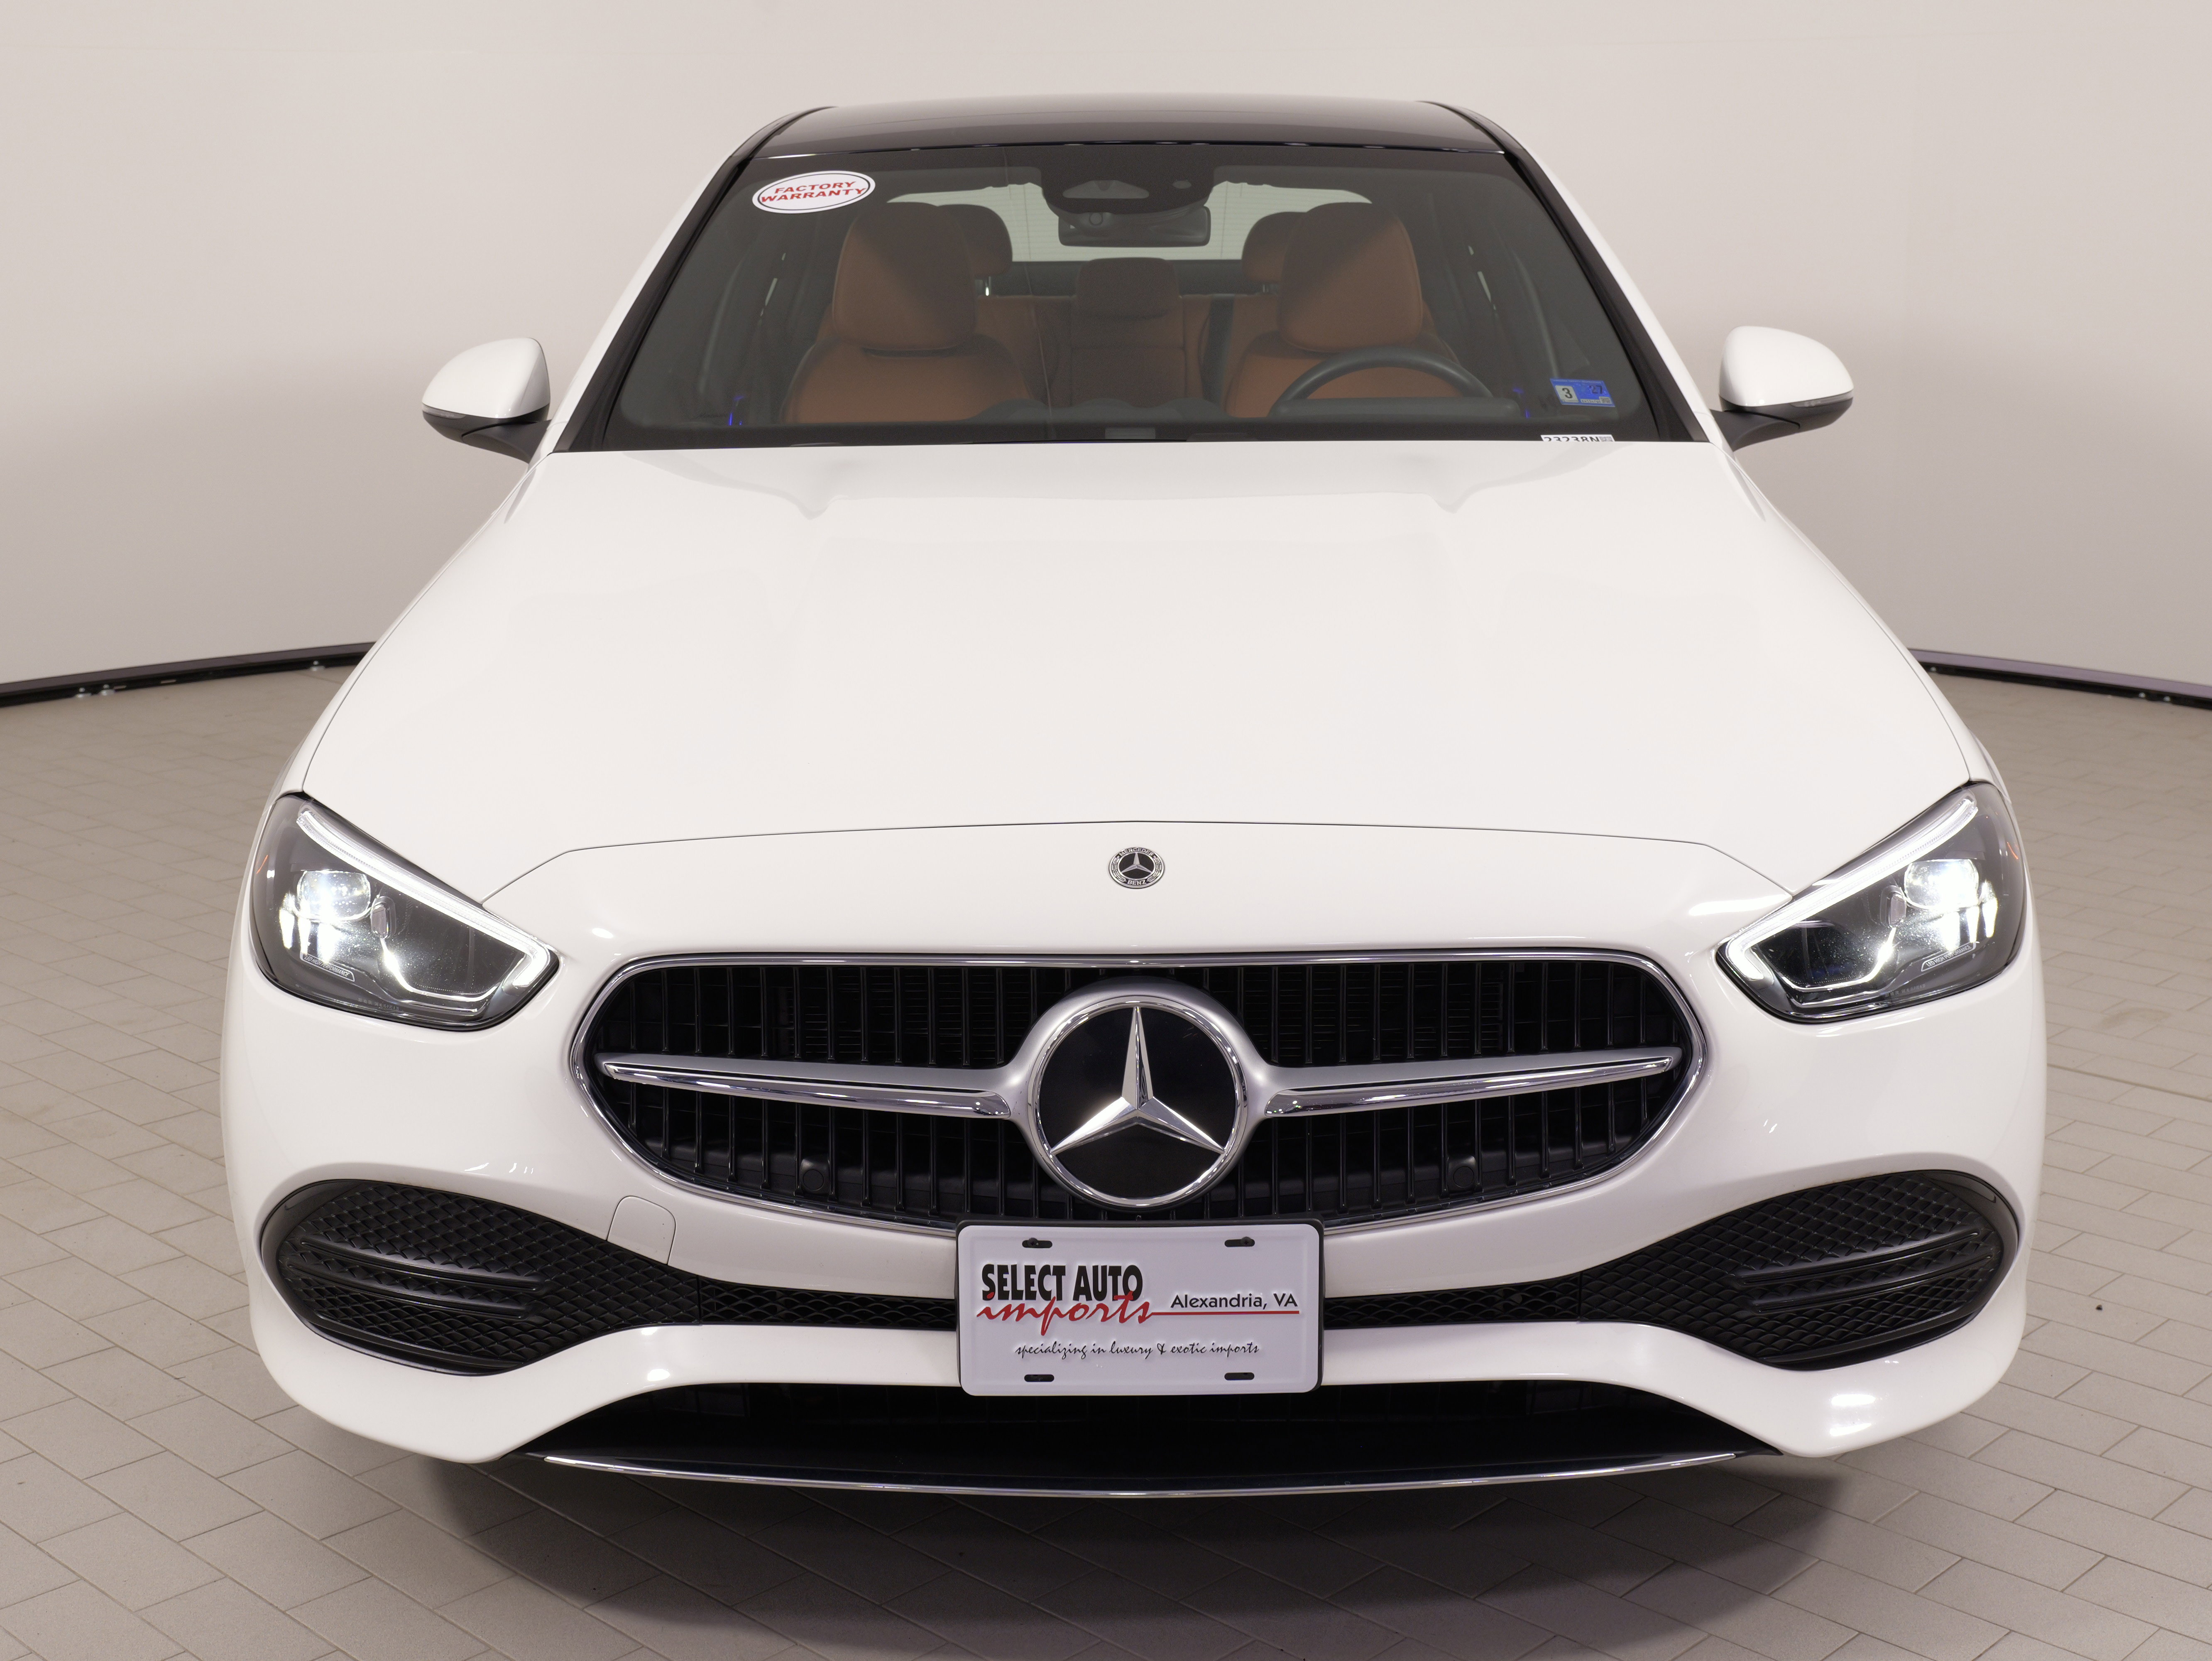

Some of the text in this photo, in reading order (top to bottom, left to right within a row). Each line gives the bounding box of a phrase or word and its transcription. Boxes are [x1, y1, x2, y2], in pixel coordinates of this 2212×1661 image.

[774, 181, 856, 194] FACTORY
[761, 188, 866, 203] WARRANTY
[1562, 388, 1573, 399] 3
[1589, 385, 1603, 394] 27
[1119, 848, 1154, 856] MERCEDES
[1945, 945, 1972, 959] PERFORMANCE
[321, 962, 350, 977] PERFORMANCE
[981, 1264, 1143, 1301] SELECT AUTO
[1170, 1293, 1298, 1310] Alexandria, VA
[976, 1290, 1152, 1336] imports
[1015, 1341, 1260, 1360] specializing in luxury & exotic imports
